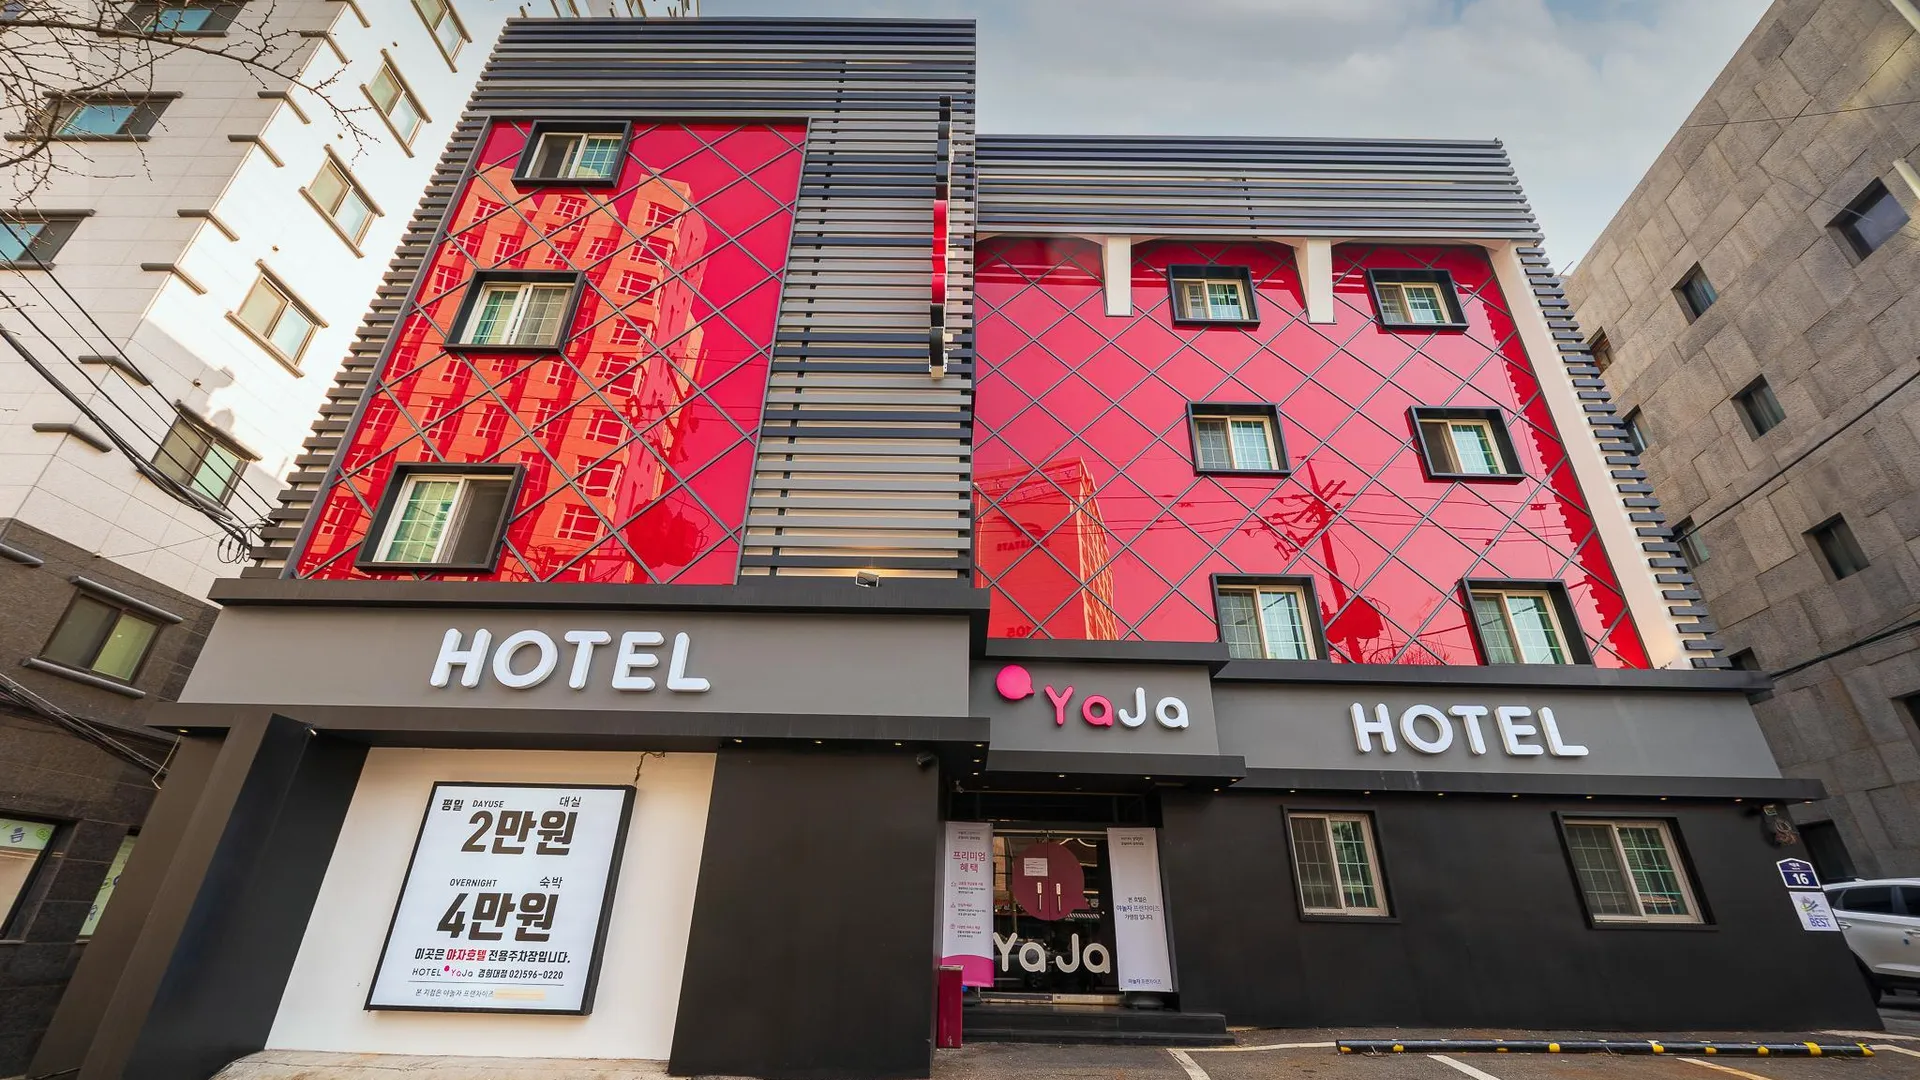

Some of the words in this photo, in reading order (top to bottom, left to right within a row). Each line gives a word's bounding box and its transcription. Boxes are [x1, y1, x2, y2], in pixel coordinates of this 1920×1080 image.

[429, 628, 711, 692] HOTEL
[1044, 685, 1190, 729] YaJa
[1350, 702, 1589, 756] HOTEL
[441, 798, 464, 811] 평일
[472, 799, 504, 808] DAYUSE
[559, 796, 582, 808] 대실
[461, 810, 578, 856] 2만원
[952, 851, 986, 862] 프리미엄
[959, 863, 979, 873] 혜택
[450, 878, 498, 888] OVERNIGHT
[539, 876, 563, 889] 숙박
[1792, 873, 1809, 885] 16
[436, 892, 559, 942] 4만원
[1809, 917, 1831, 928] BEST
[414, 948, 445, 961] 이곳은
[446, 949, 487, 962] 야자호텔
[488, 950, 571, 964] 전용주차장입니다.
[412, 968, 442, 977] HOTEL
[451, 968, 474, 978] YaJa
[478, 969, 508, 979] 경희대점
[509, 969, 564, 981] 02)596-0220
